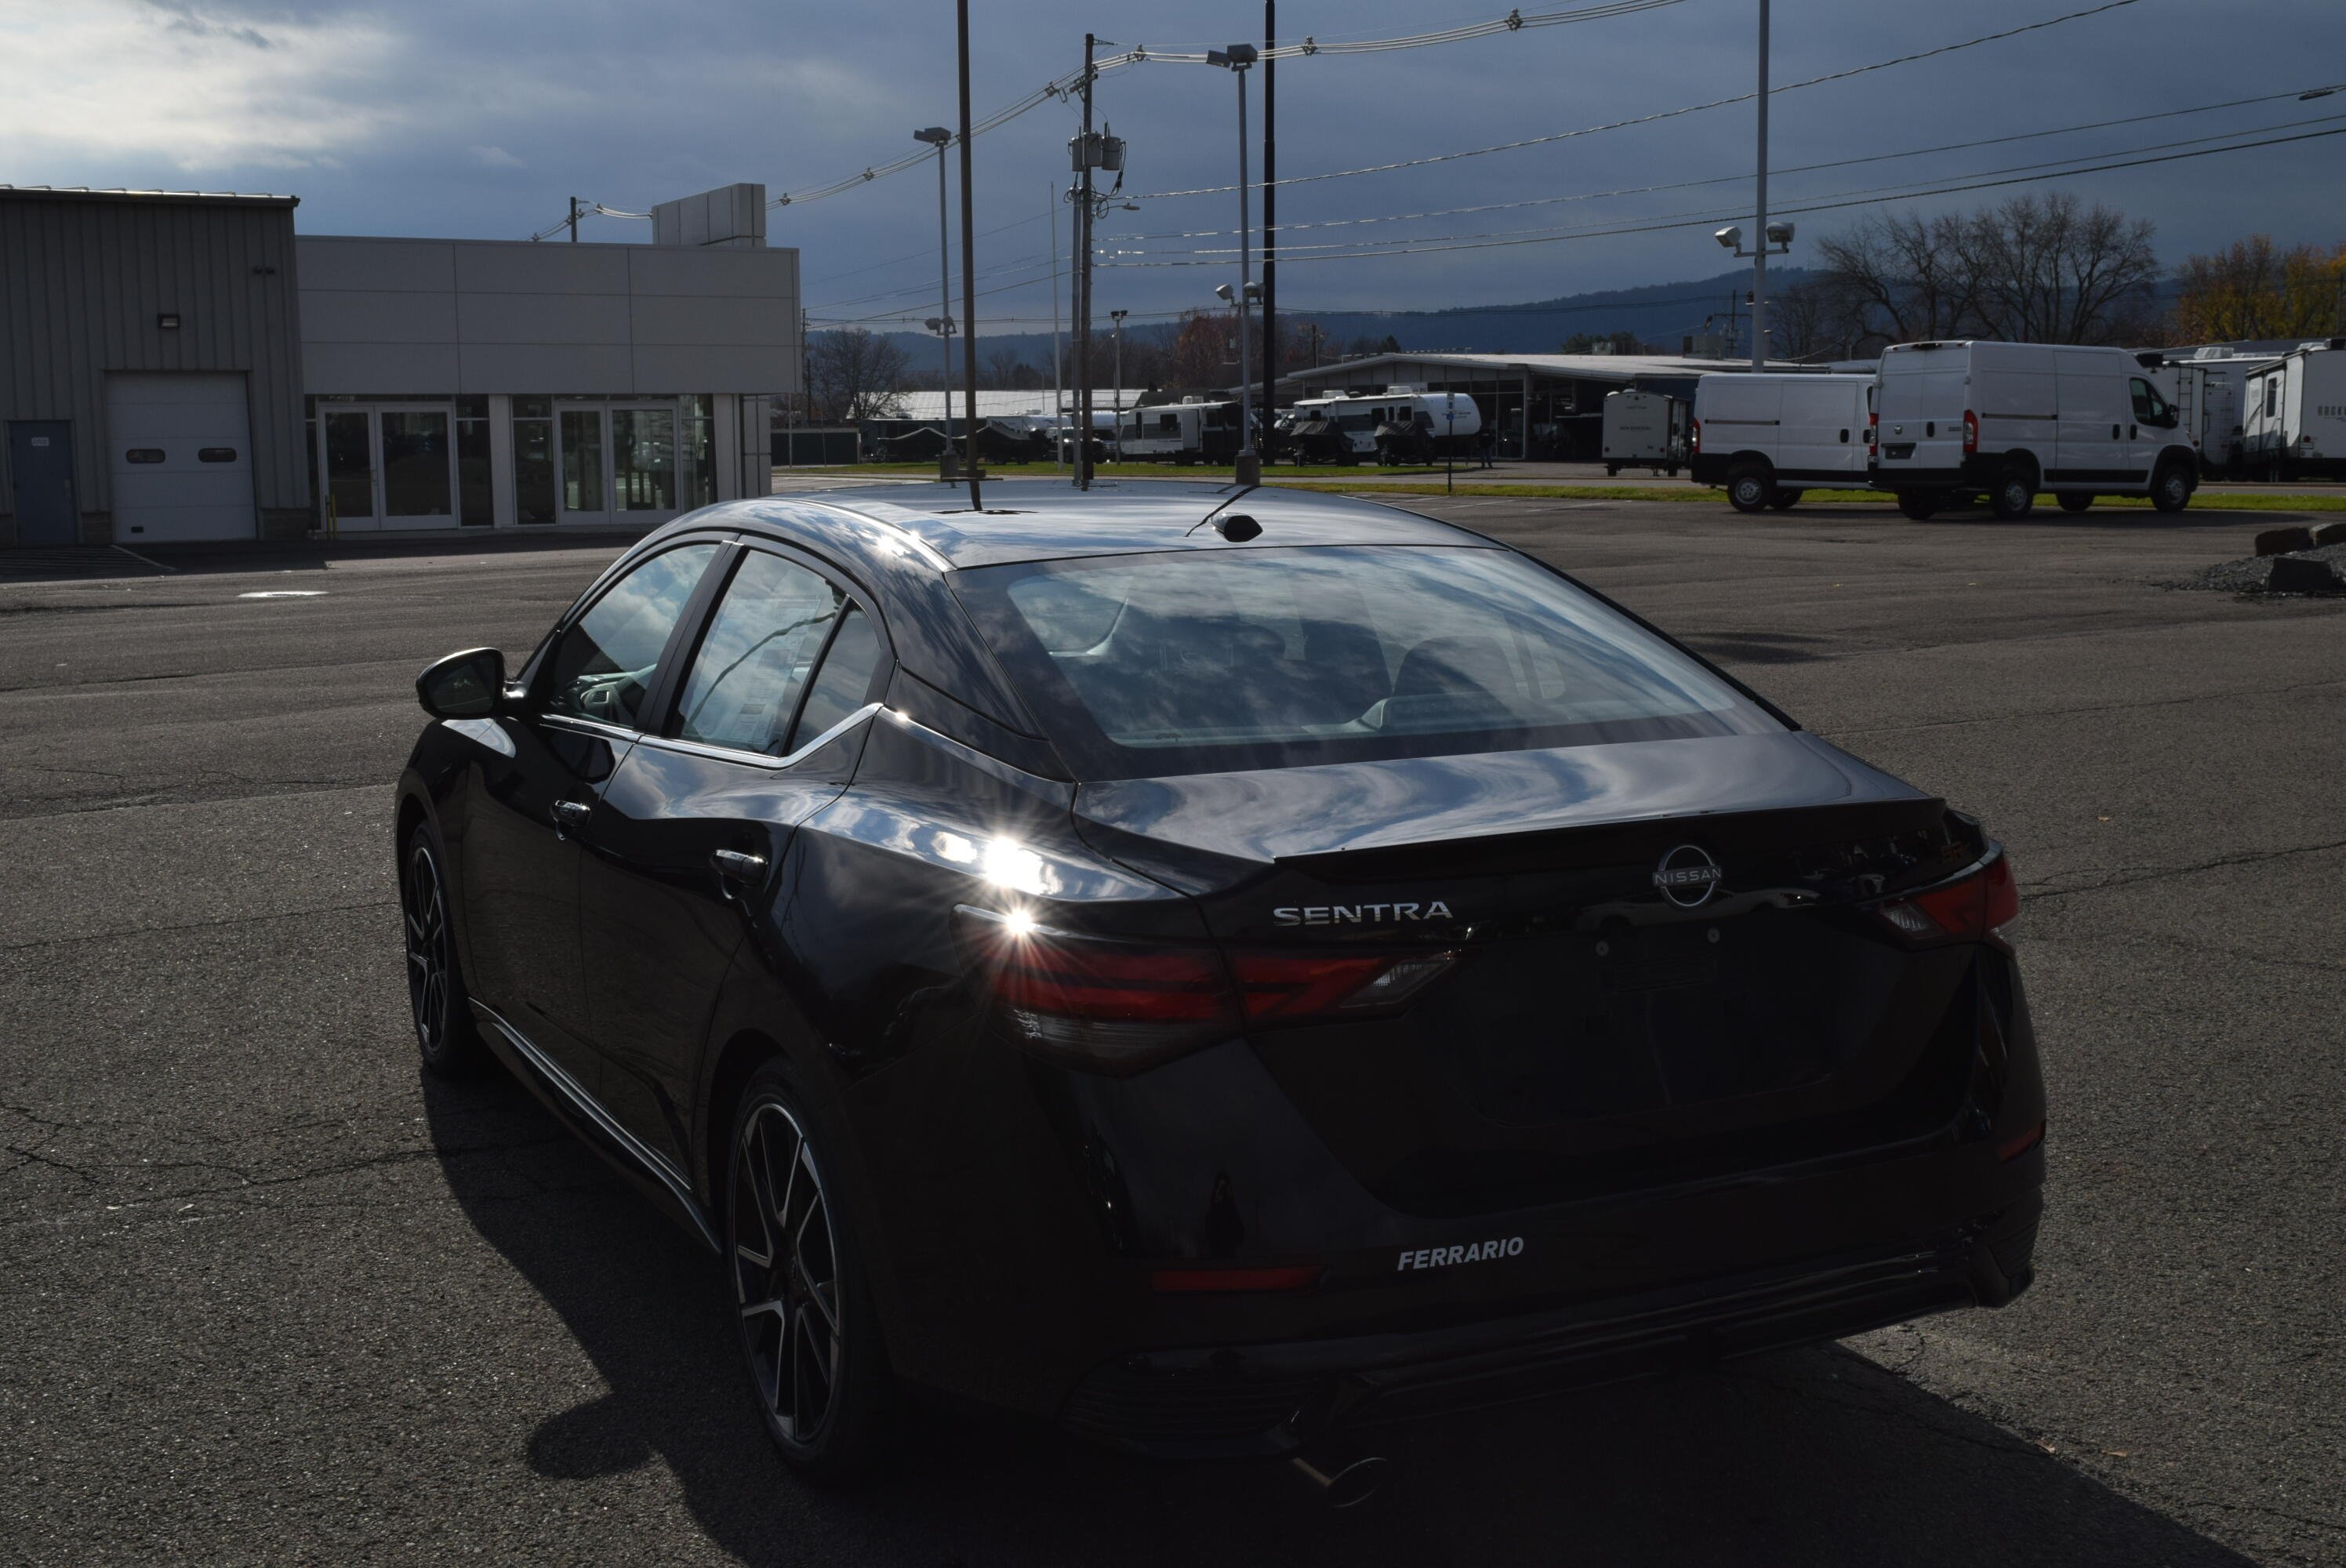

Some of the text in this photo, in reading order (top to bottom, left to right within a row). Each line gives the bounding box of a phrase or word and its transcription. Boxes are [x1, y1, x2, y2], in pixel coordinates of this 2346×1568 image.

[1654, 867, 1721, 884] NISSAN
[1273, 901, 1454, 926] SENTRA
[1396, 1236, 1524, 1272] FERRARIO
